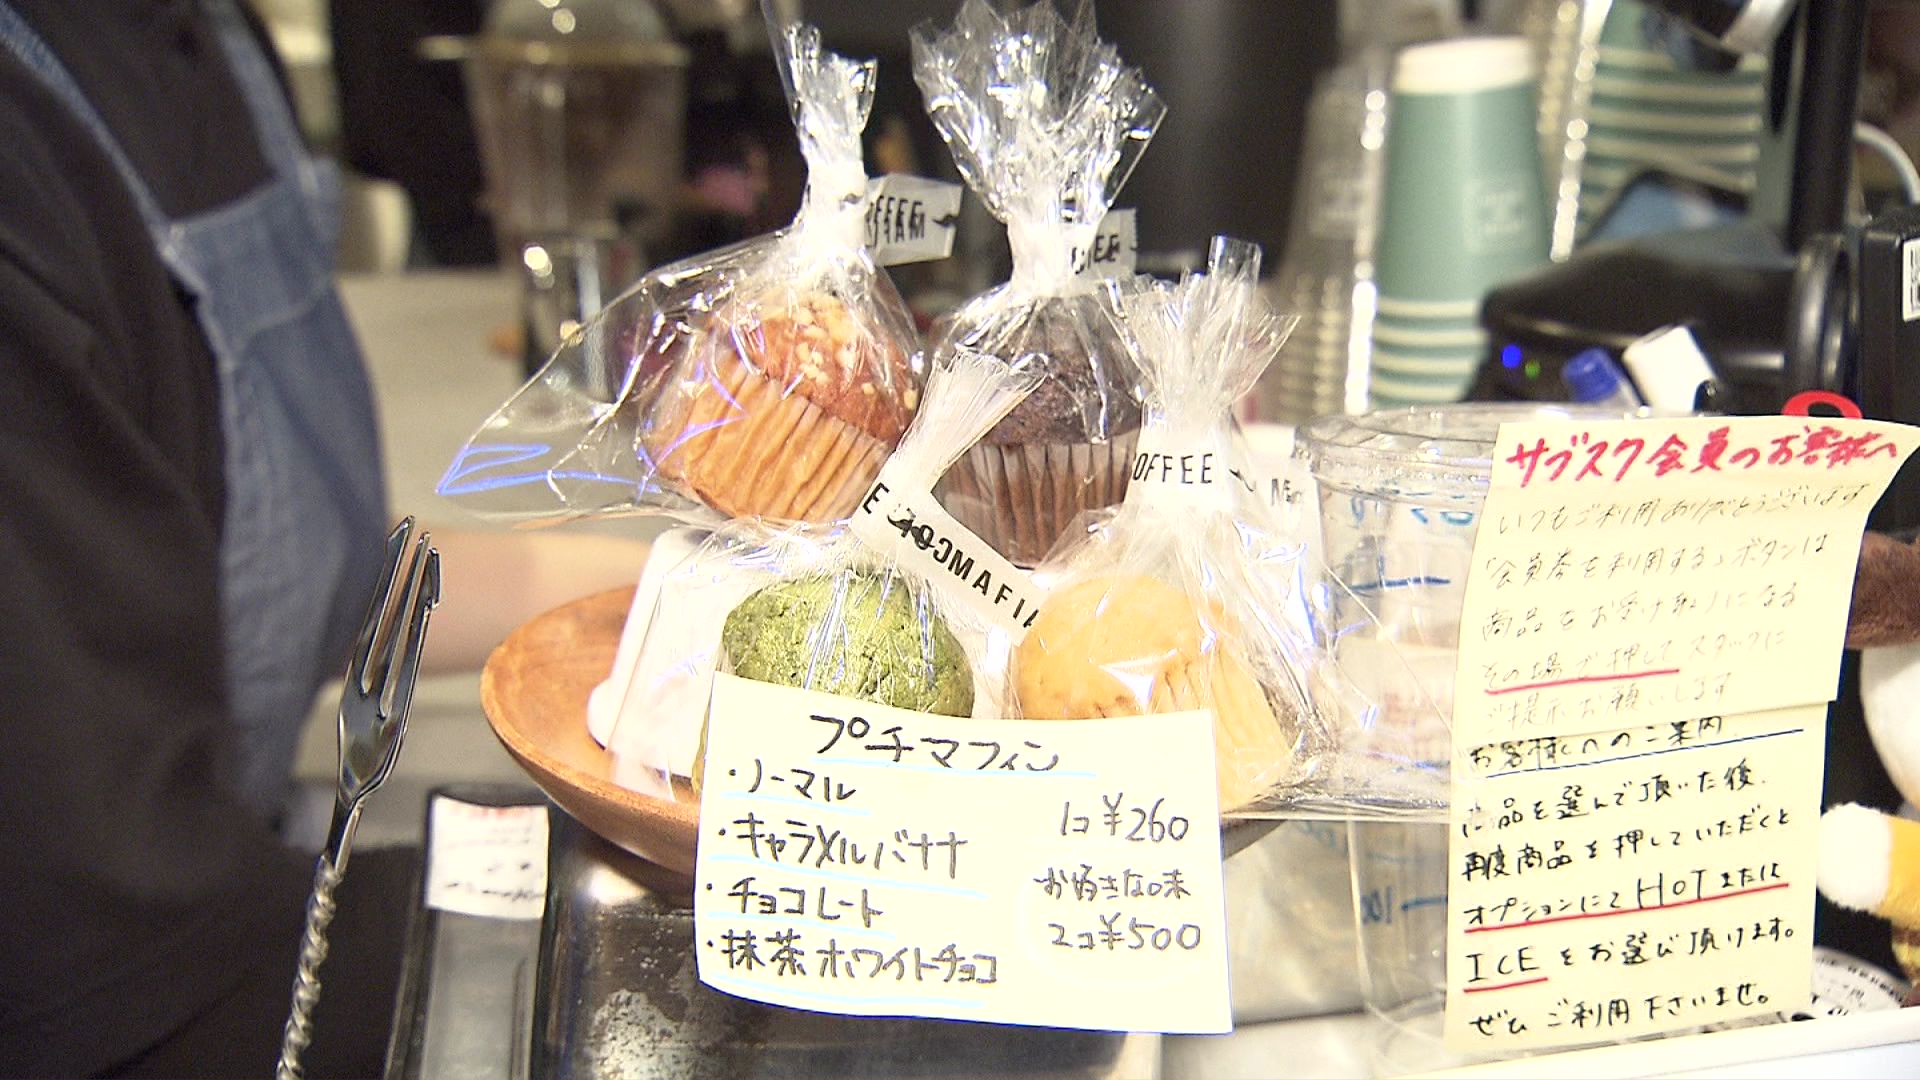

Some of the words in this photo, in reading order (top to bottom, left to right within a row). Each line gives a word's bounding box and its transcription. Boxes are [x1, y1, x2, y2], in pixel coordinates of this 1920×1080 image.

[809, 714, 1059, 772] プチマフィン
[1462, 805, 1790, 881] 再度商品を押していただくと
[1032, 863, 1191, 902] お好きな味
[1470, 982, 1770, 1036] ぜひご利用下さいませ。
